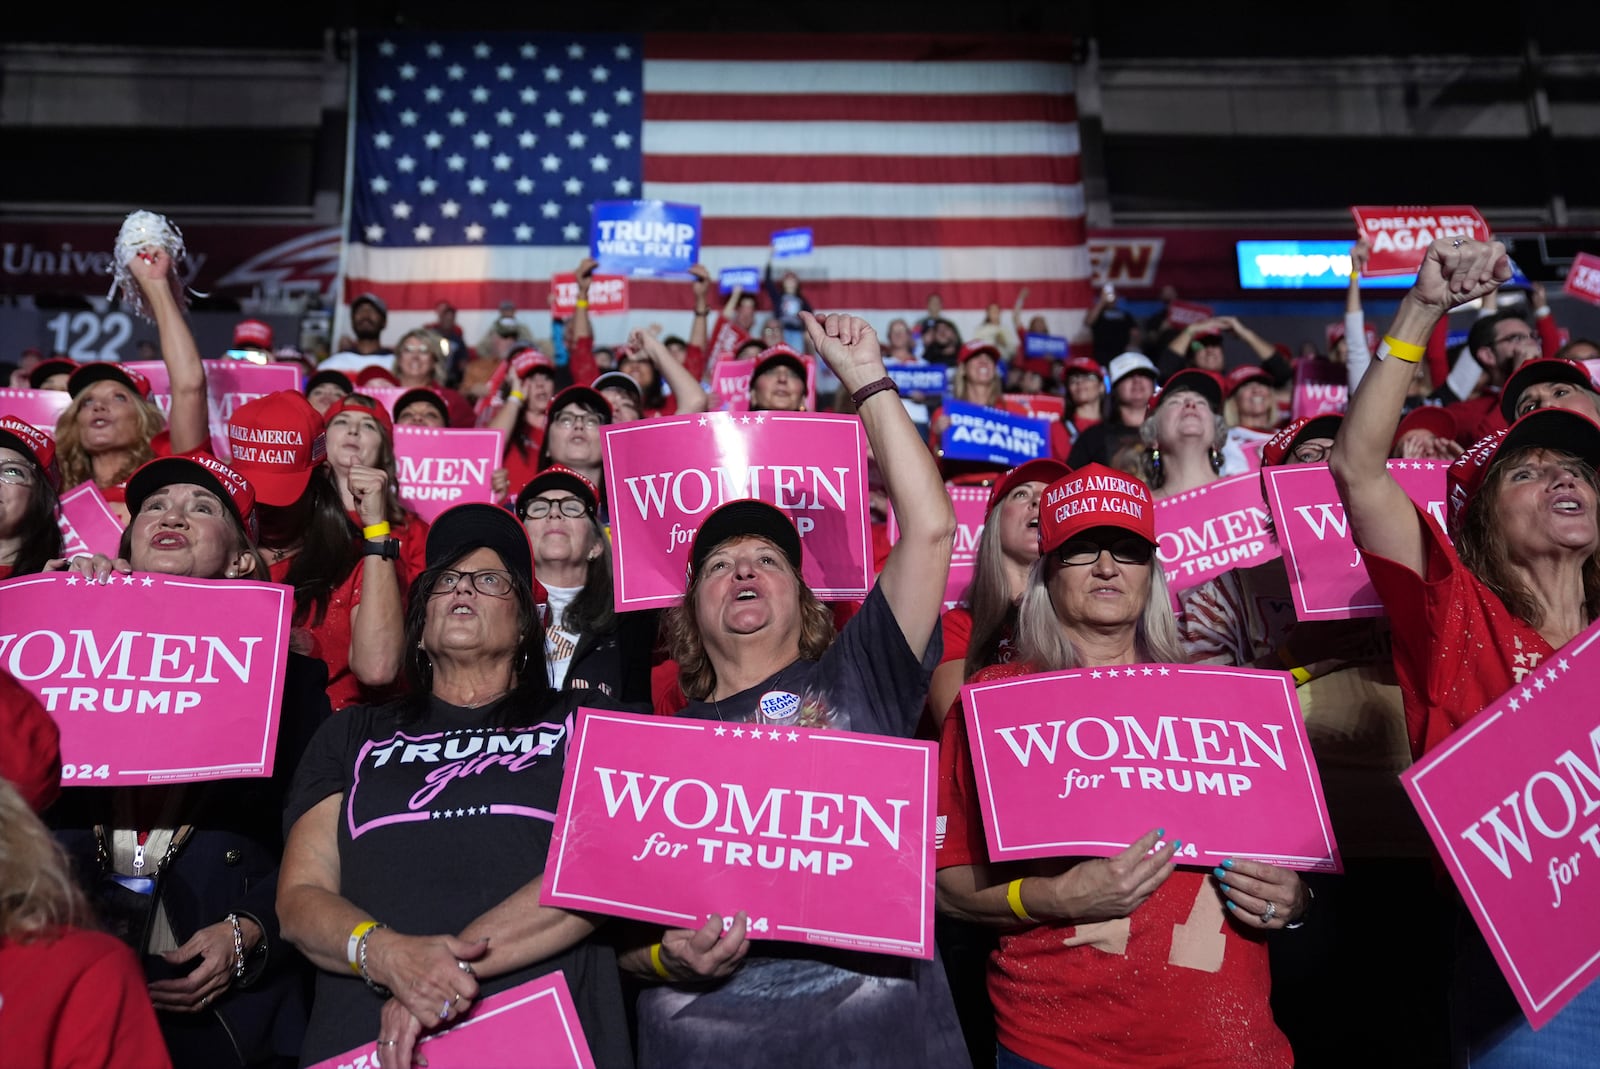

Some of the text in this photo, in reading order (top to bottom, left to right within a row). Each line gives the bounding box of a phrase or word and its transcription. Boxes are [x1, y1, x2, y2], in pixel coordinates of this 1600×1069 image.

[598, 220, 695, 244] TRUMP
[1366, 215, 1481, 231] DREAM BIG,
[597, 240, 694, 259] WILL FIX IT
[47, 311, 132, 362] 122
[249, 428, 303, 445] AMERICA
[950, 413, 1009, 434] DREAM
[1012, 427, 1045, 447] BIG,
[952, 425, 1038, 457] AGAIN!
[258, 446, 296, 464] AGAIN
[396, 456, 490, 485] MEN
[192, 456, 247, 491] MERICA
[400, 485, 462, 500] RUMP
[624, 465, 850, 521] WOMEN
[1046, 475, 1148, 508] MAKE AMERICA
[1055, 497, 1142, 524] GREAT AGAIN
[666, 523, 697, 553] for
[1155, 506, 1272, 562] OMEN
[1180, 541, 1264, 575] TRUMP
[40, 687, 201, 714] TRUMP
[762, 694, 792, 707] TEAM
[763, 696, 798, 714] TRUMP
[370, 727, 566, 769] TRUMP
[994, 716, 1283, 771] WOMEN
[61, 764, 110, 780] 024
[408, 744, 549, 810] girl
[1058, 766, 1252, 799] for TRUMP
[594, 766, 909, 850] WOMEN
[633, 832, 853, 876] for TRUMP
[1548, 852, 1581, 908] for
